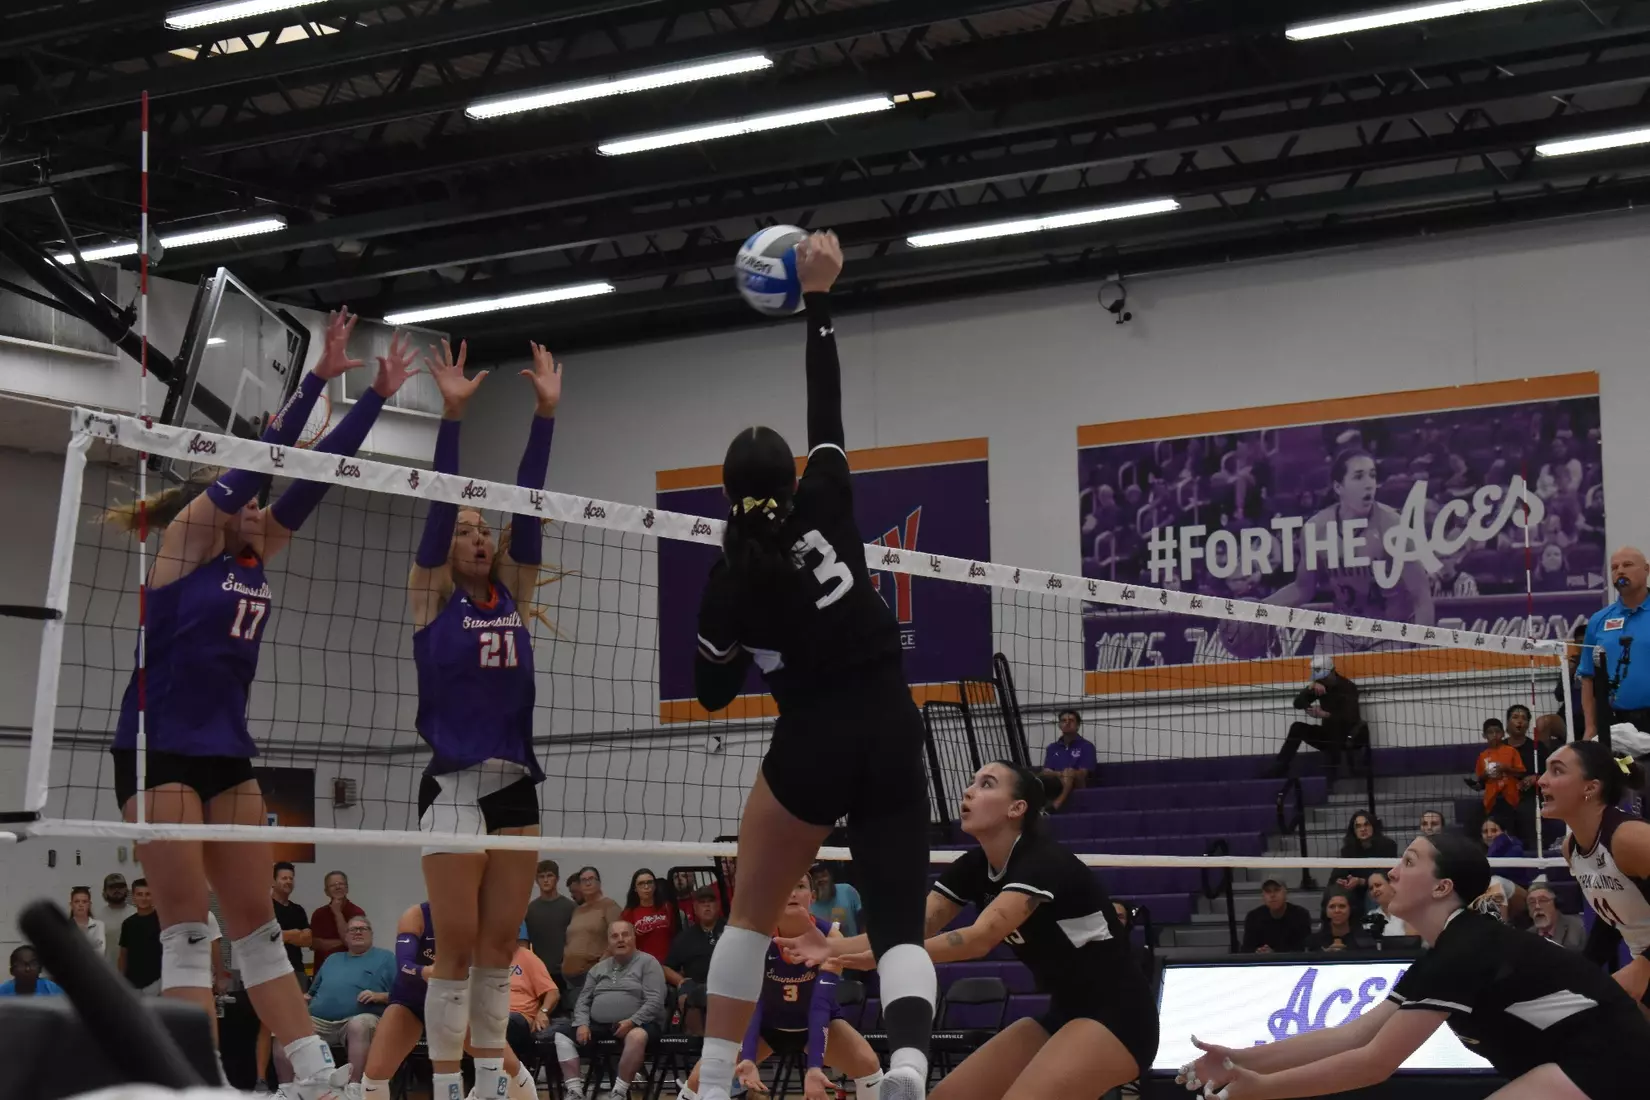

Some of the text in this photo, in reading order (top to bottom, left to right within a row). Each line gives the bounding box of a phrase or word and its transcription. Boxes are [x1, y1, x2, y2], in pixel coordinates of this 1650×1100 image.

[187, 433, 217, 454] Aces
[335, 457, 362, 478] Aces
[461, 480, 487, 500] Aces
[583, 500, 606, 520] Aces
[690, 518, 712, 536] Aces
[790, 528, 855, 610] 3
[229, 598, 266, 640] 17
[480, 630, 518, 668] 21
[1593, 897, 1626, 927] 11
[782, 983, 799, 1003] 3
